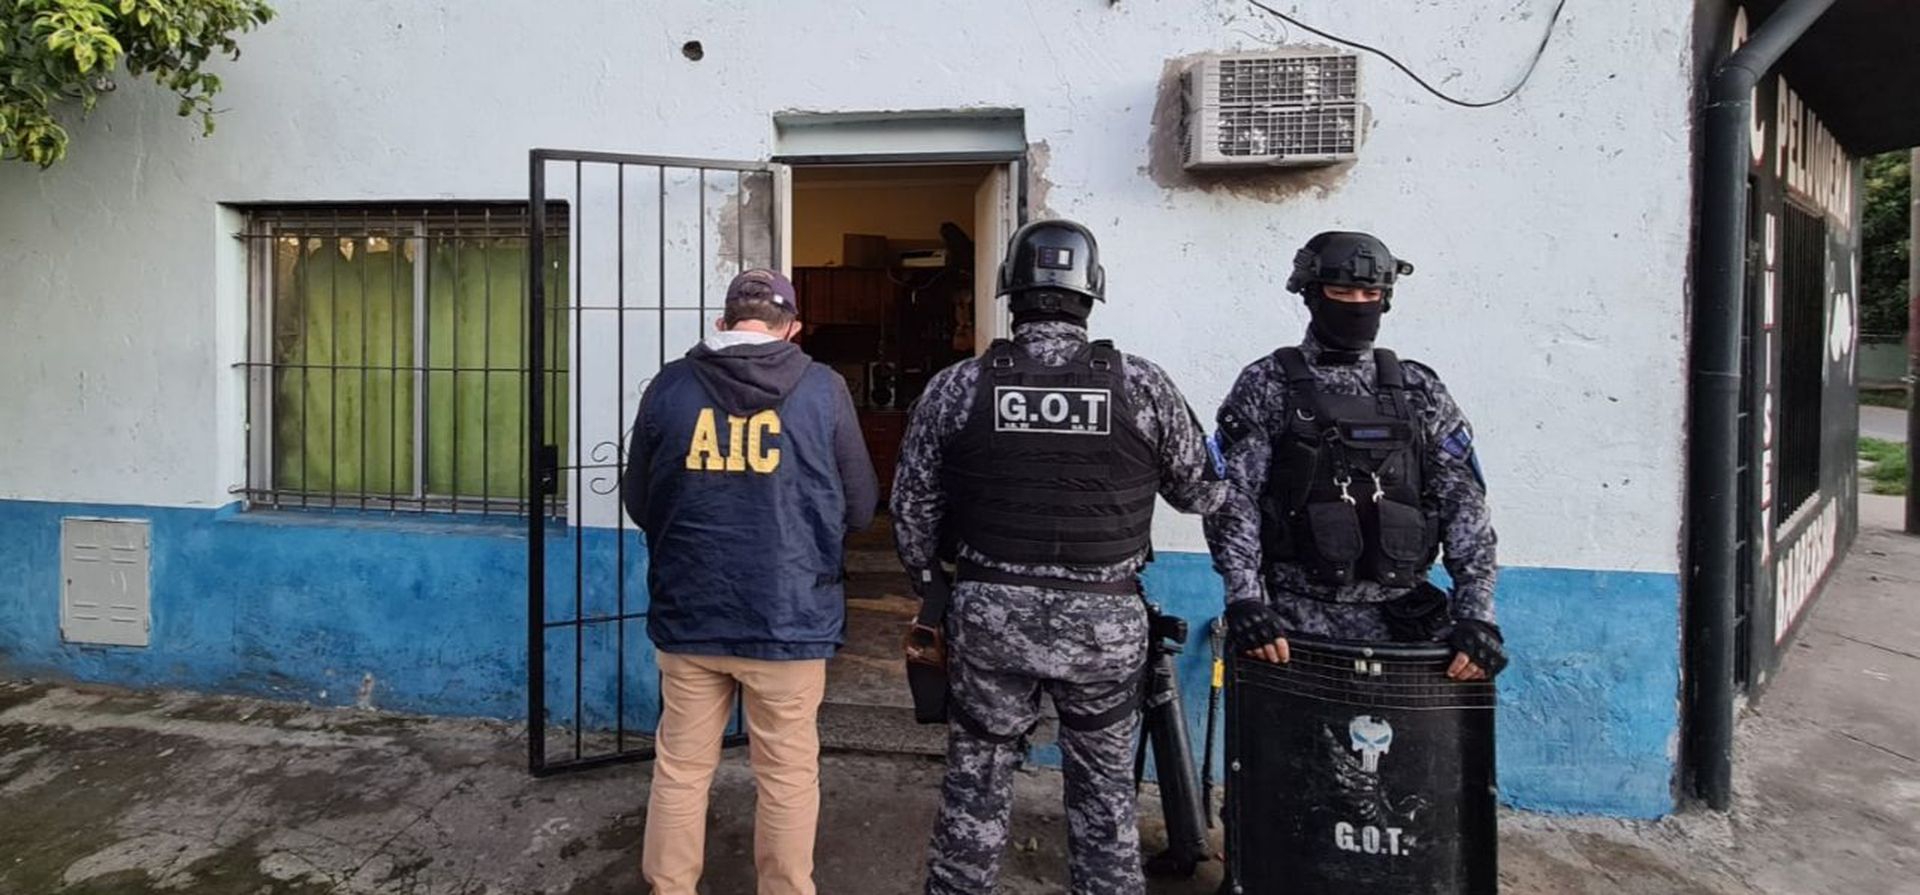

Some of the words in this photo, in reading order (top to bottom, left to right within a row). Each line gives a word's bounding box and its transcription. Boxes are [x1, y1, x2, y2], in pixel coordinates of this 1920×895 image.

[1000, 391, 1106, 424] G.O.T
[1761, 212, 1775, 567] UNISEX
[686, 408, 781, 473] AIC
[1335, 821, 1410, 856] G.O.T.
